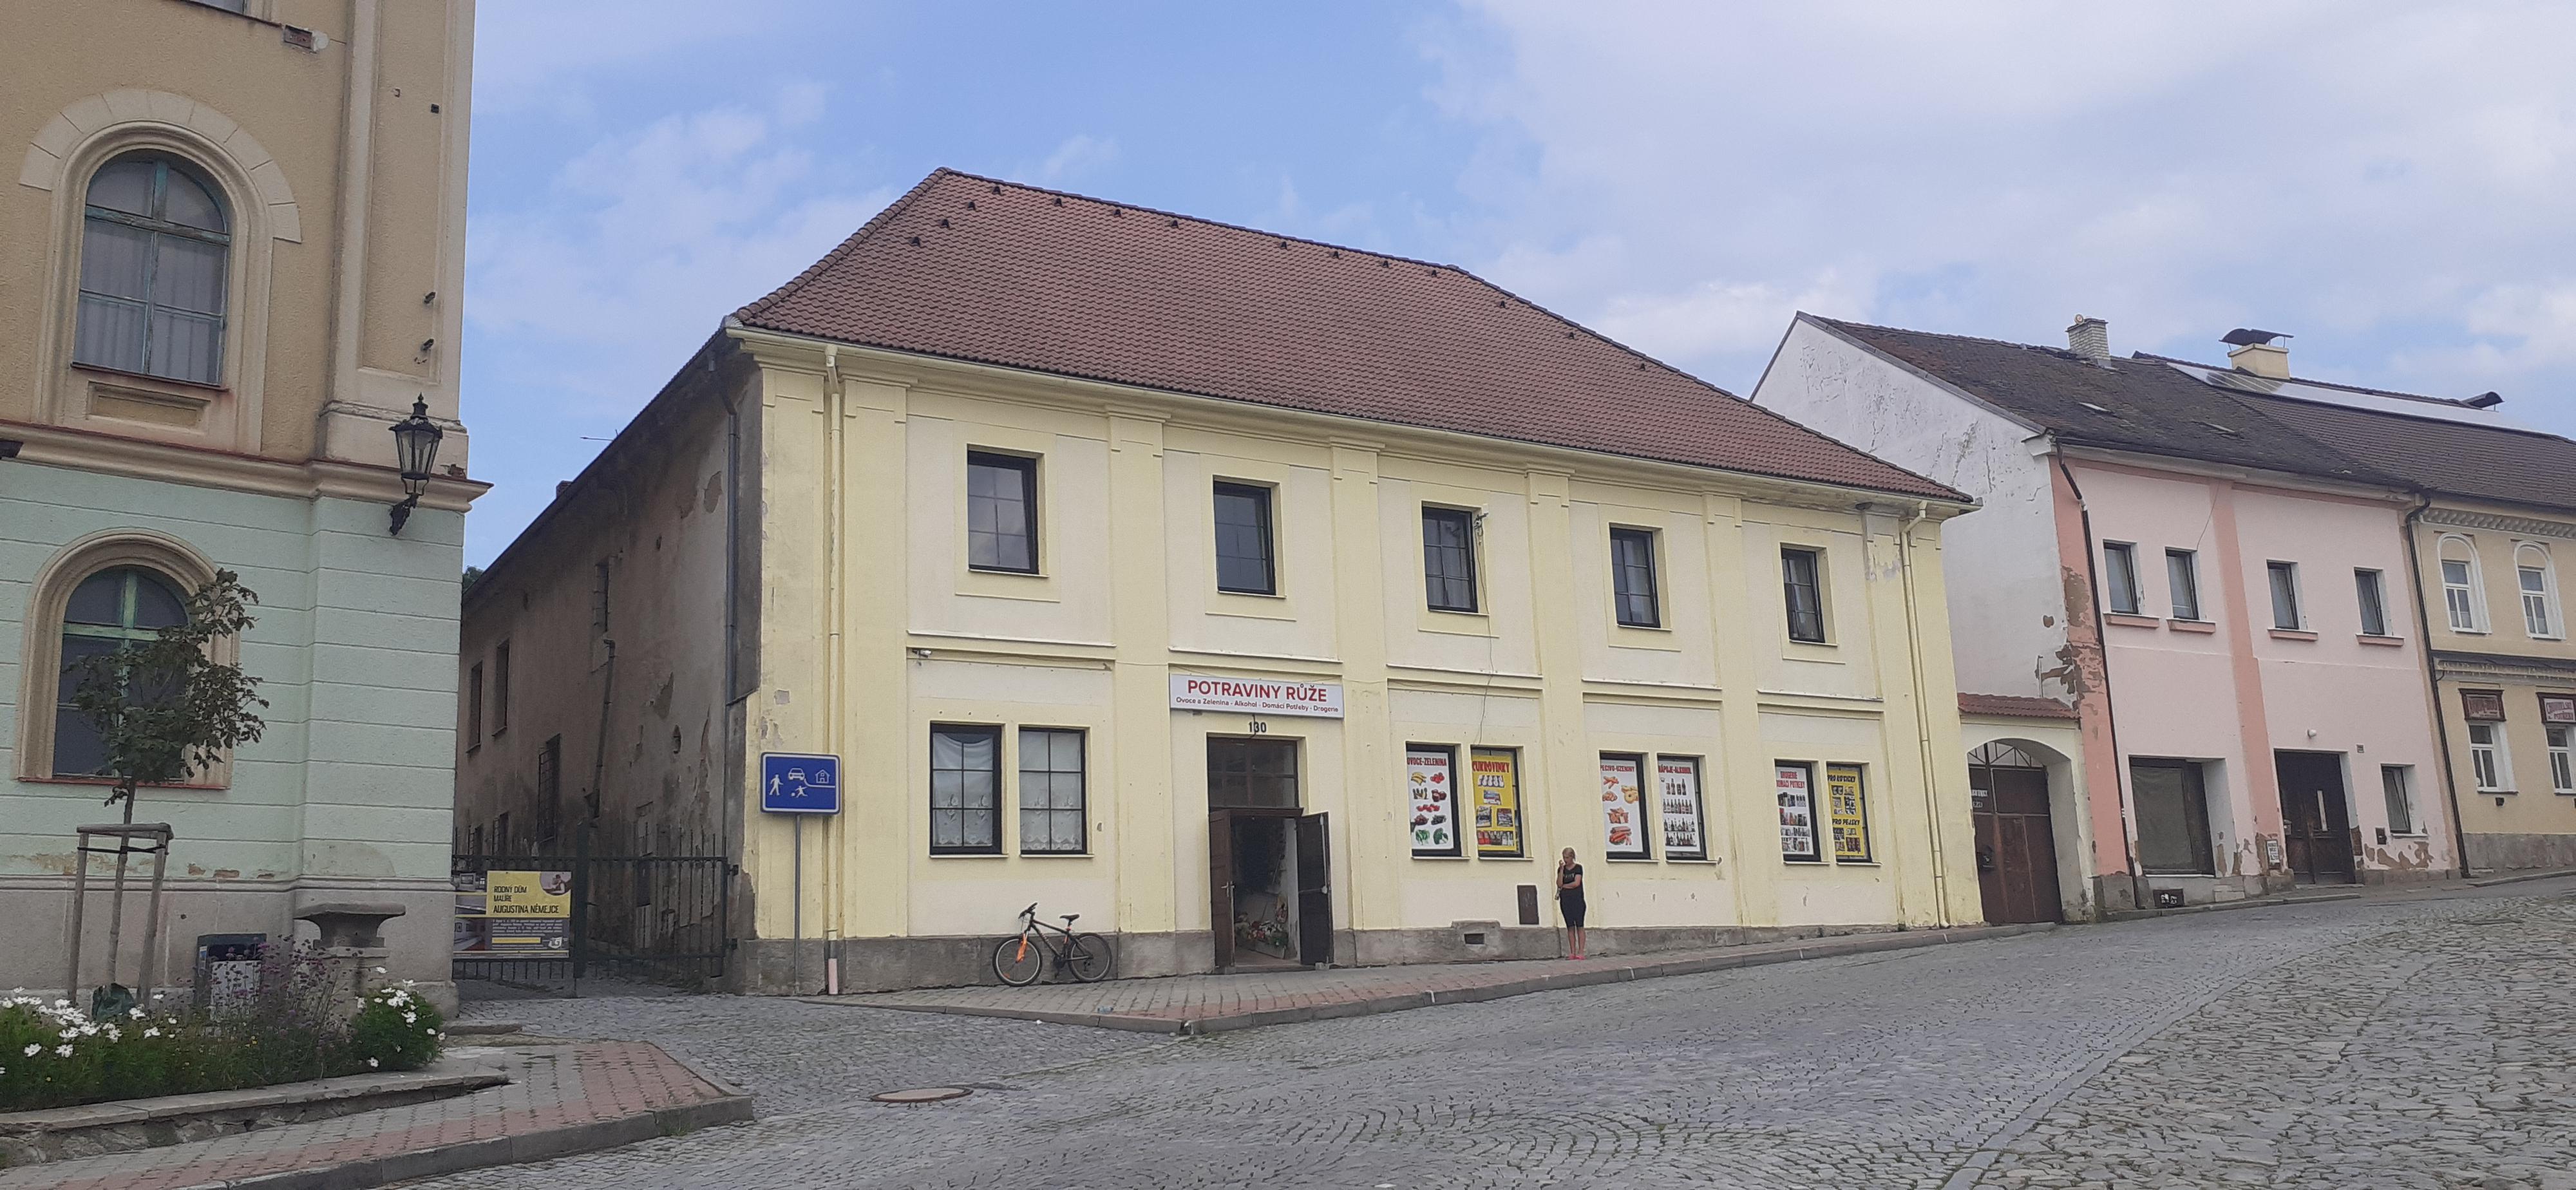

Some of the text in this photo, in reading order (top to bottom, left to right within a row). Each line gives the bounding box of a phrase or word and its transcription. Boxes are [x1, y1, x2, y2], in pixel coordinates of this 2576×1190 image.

[1188, 679, 1327, 702] POTRAVINY RŮŽE
[1249, 721, 1267, 733] 130
[493, 905, 529, 913] AUGUSTINA
